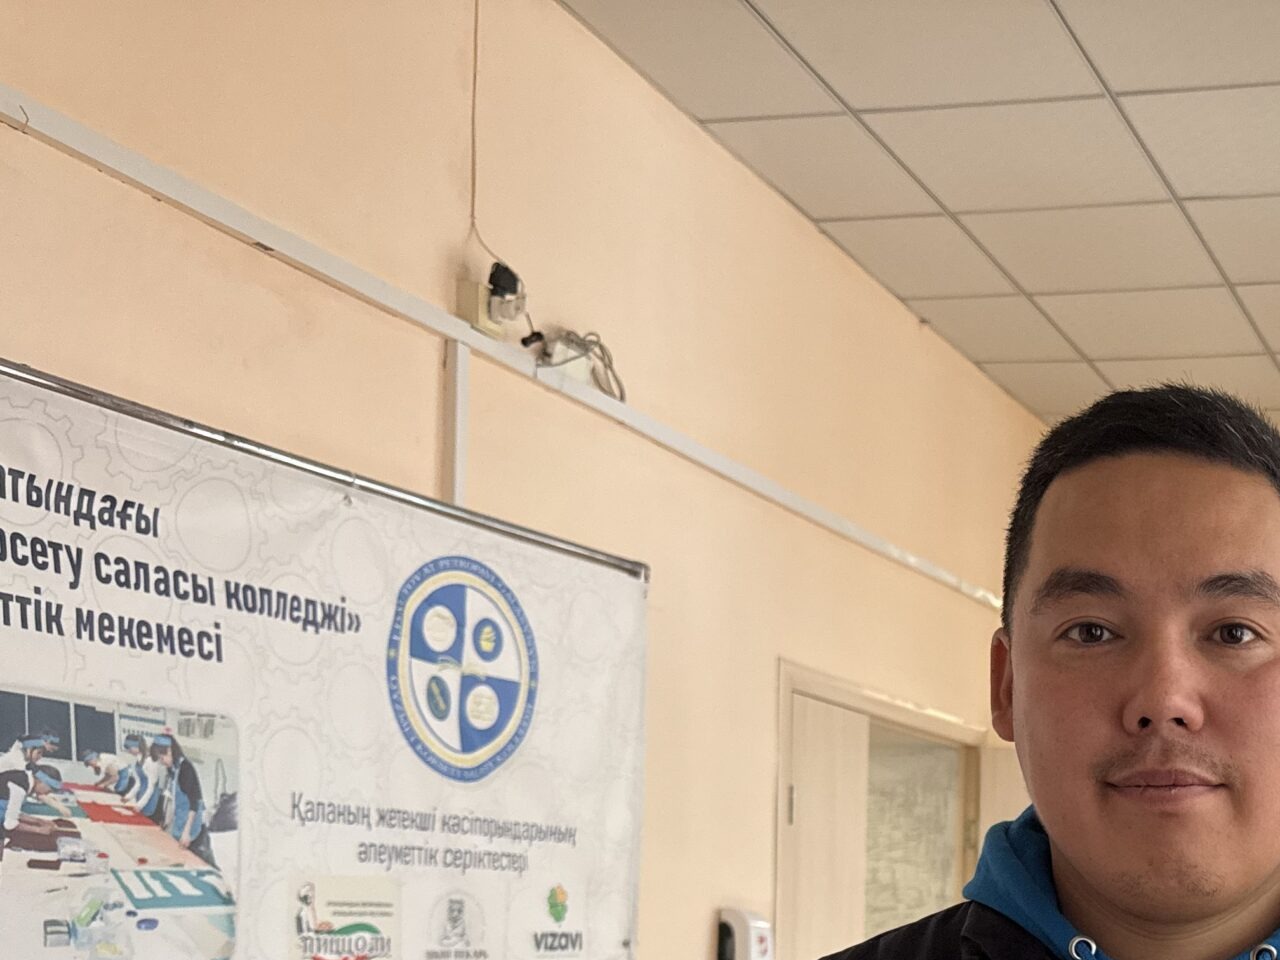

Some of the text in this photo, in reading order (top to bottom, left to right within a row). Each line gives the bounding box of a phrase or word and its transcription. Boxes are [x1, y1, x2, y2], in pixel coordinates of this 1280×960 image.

[94, 552, 216, 606] саласы
[224, 580, 361, 634] колледжі»
[75, 607, 223, 663] мекемесі
[291, 791, 577, 847] Қаланың жетекші кәсіпорындарының
[358, 840, 529, 876] әлеуметтік серіктестері
